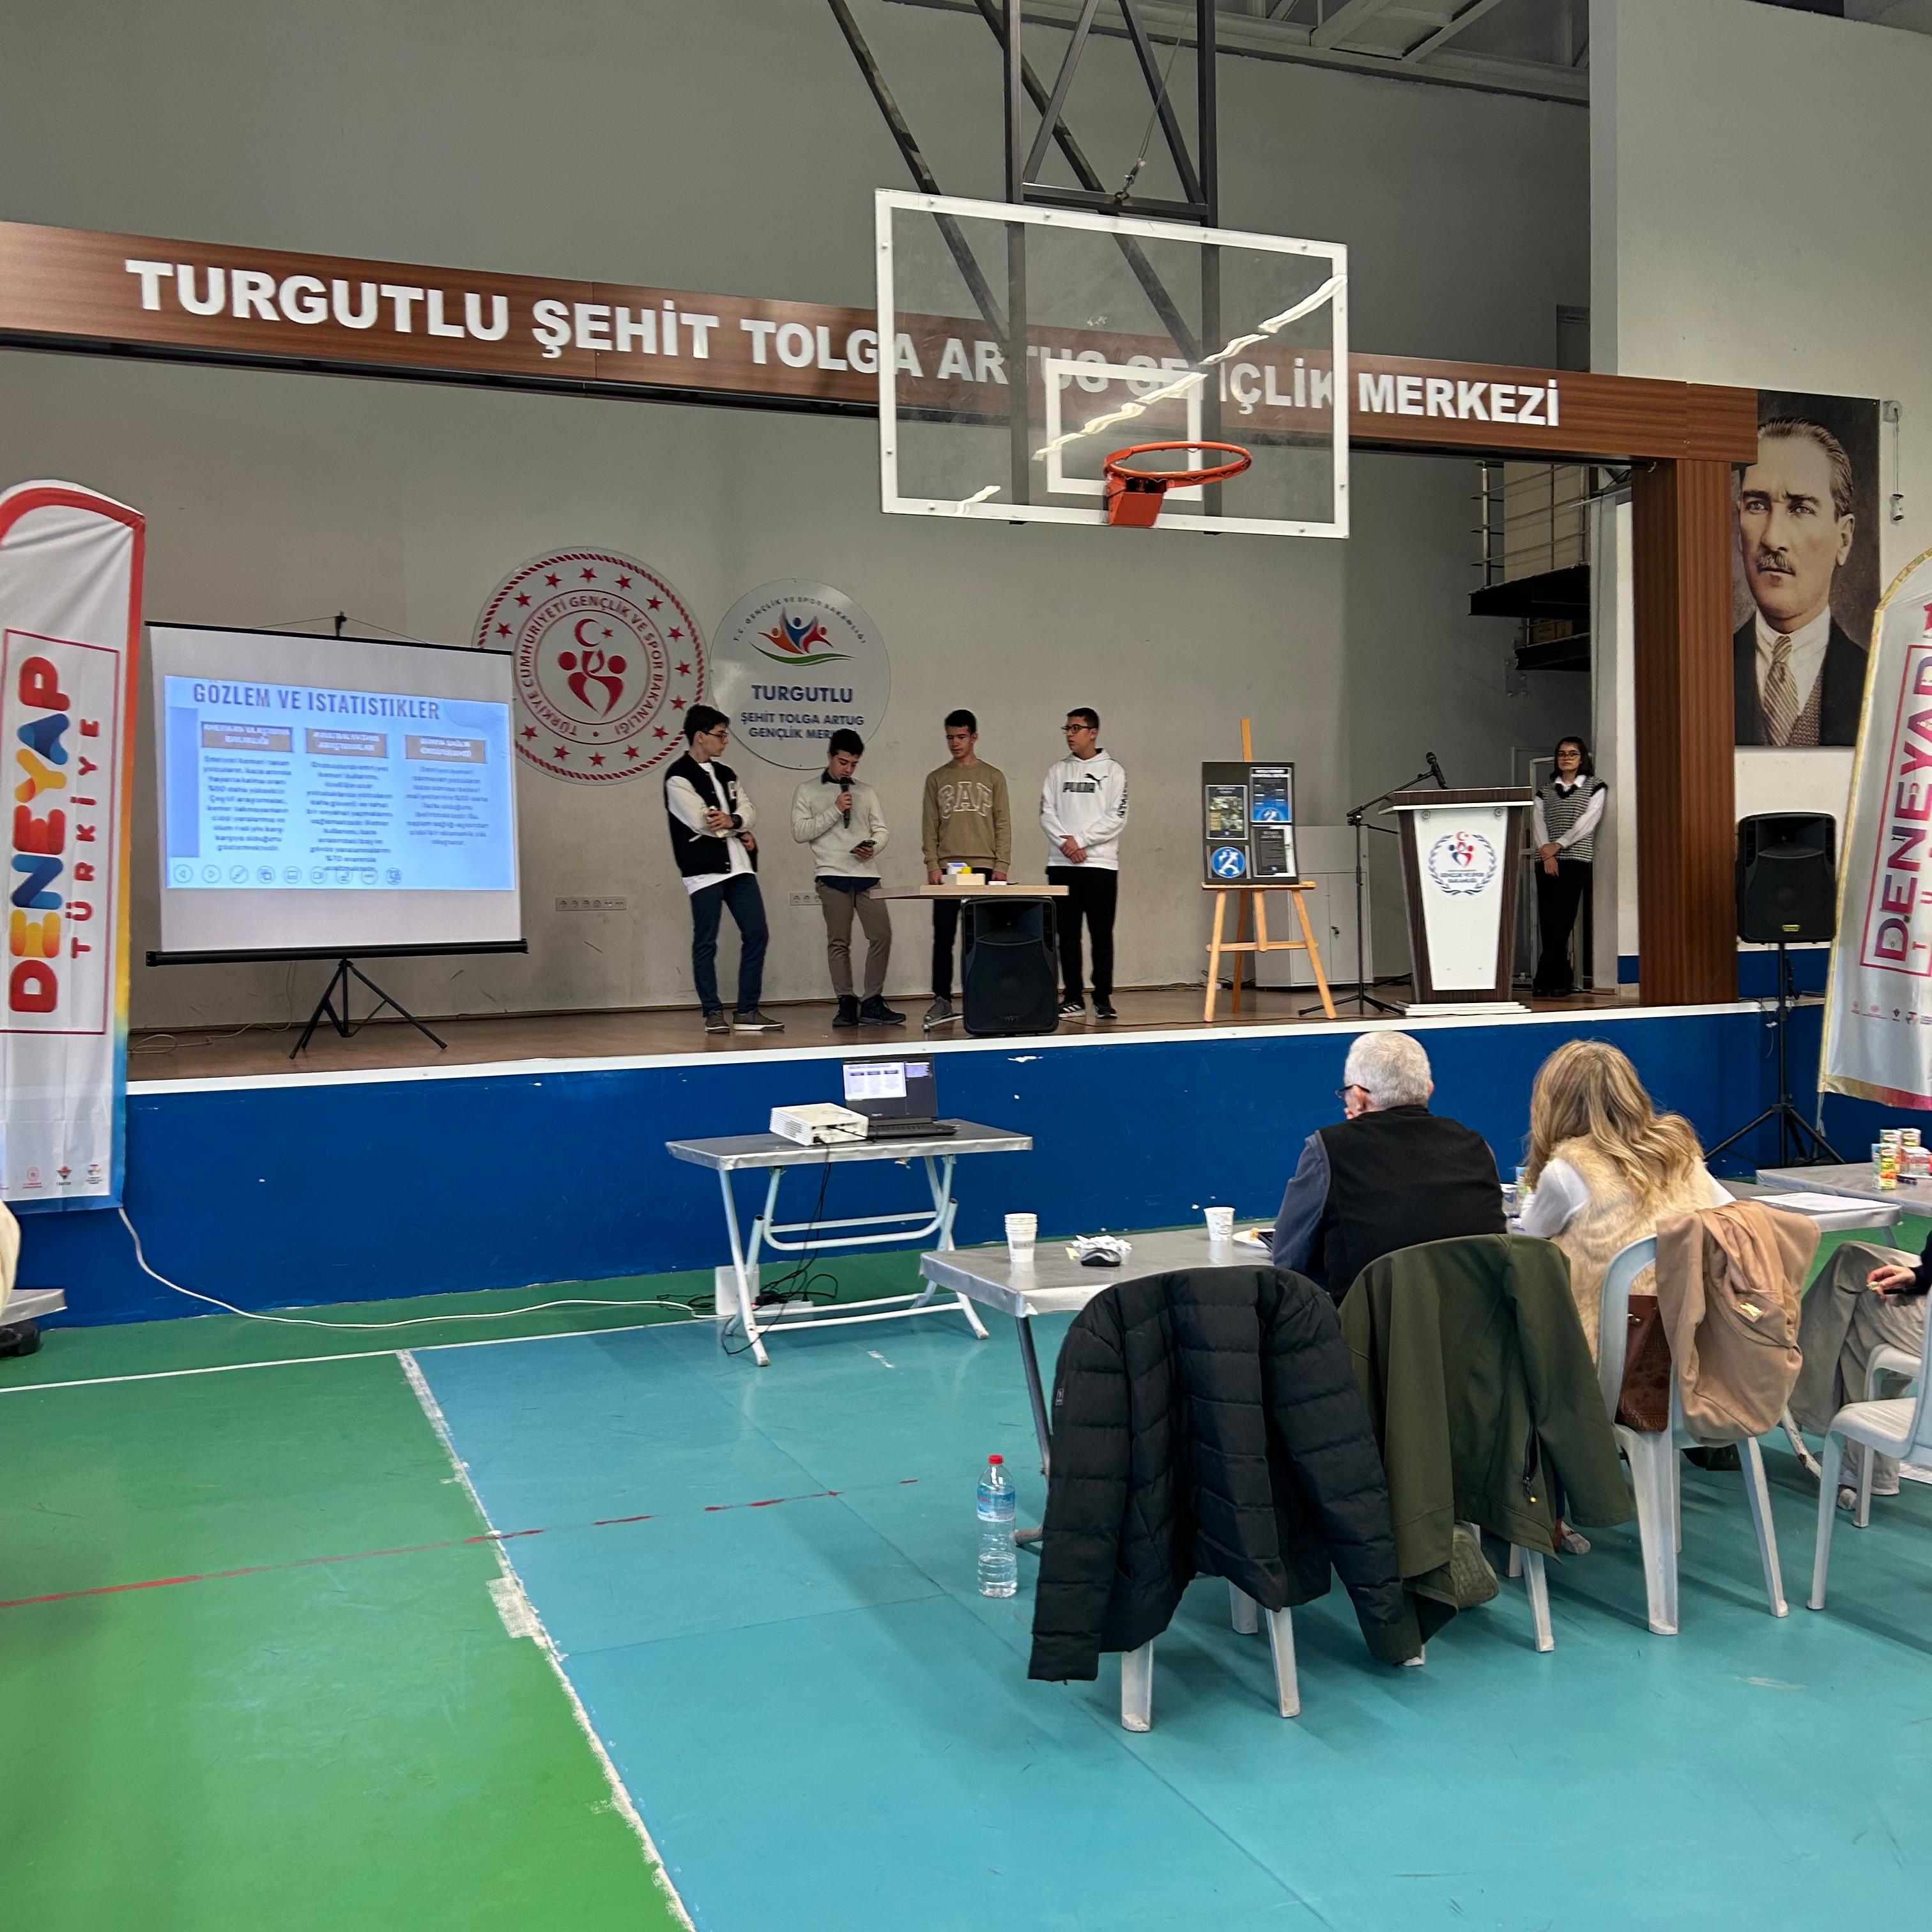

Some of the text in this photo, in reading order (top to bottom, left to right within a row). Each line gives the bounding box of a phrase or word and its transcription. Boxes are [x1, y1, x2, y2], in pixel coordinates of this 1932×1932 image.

[125, 259, 509, 341] TURGUTLU
[532, 299, 719, 358] ŞEHİT
[740, 319, 924, 378] TOLGA
[1358, 373, 1559, 427] MERKEZİ
[278, 689, 302, 709] VE
[751, 685, 853, 703] TURGUTLU
[740, 710, 864, 726] ŞEHİT TOLGA ARTUG
[749, 725, 802, 740] GENÇLİK
[8, 656, 71, 1013] DENEYAP
[65, 718, 99, 959] TÜRKİYE
